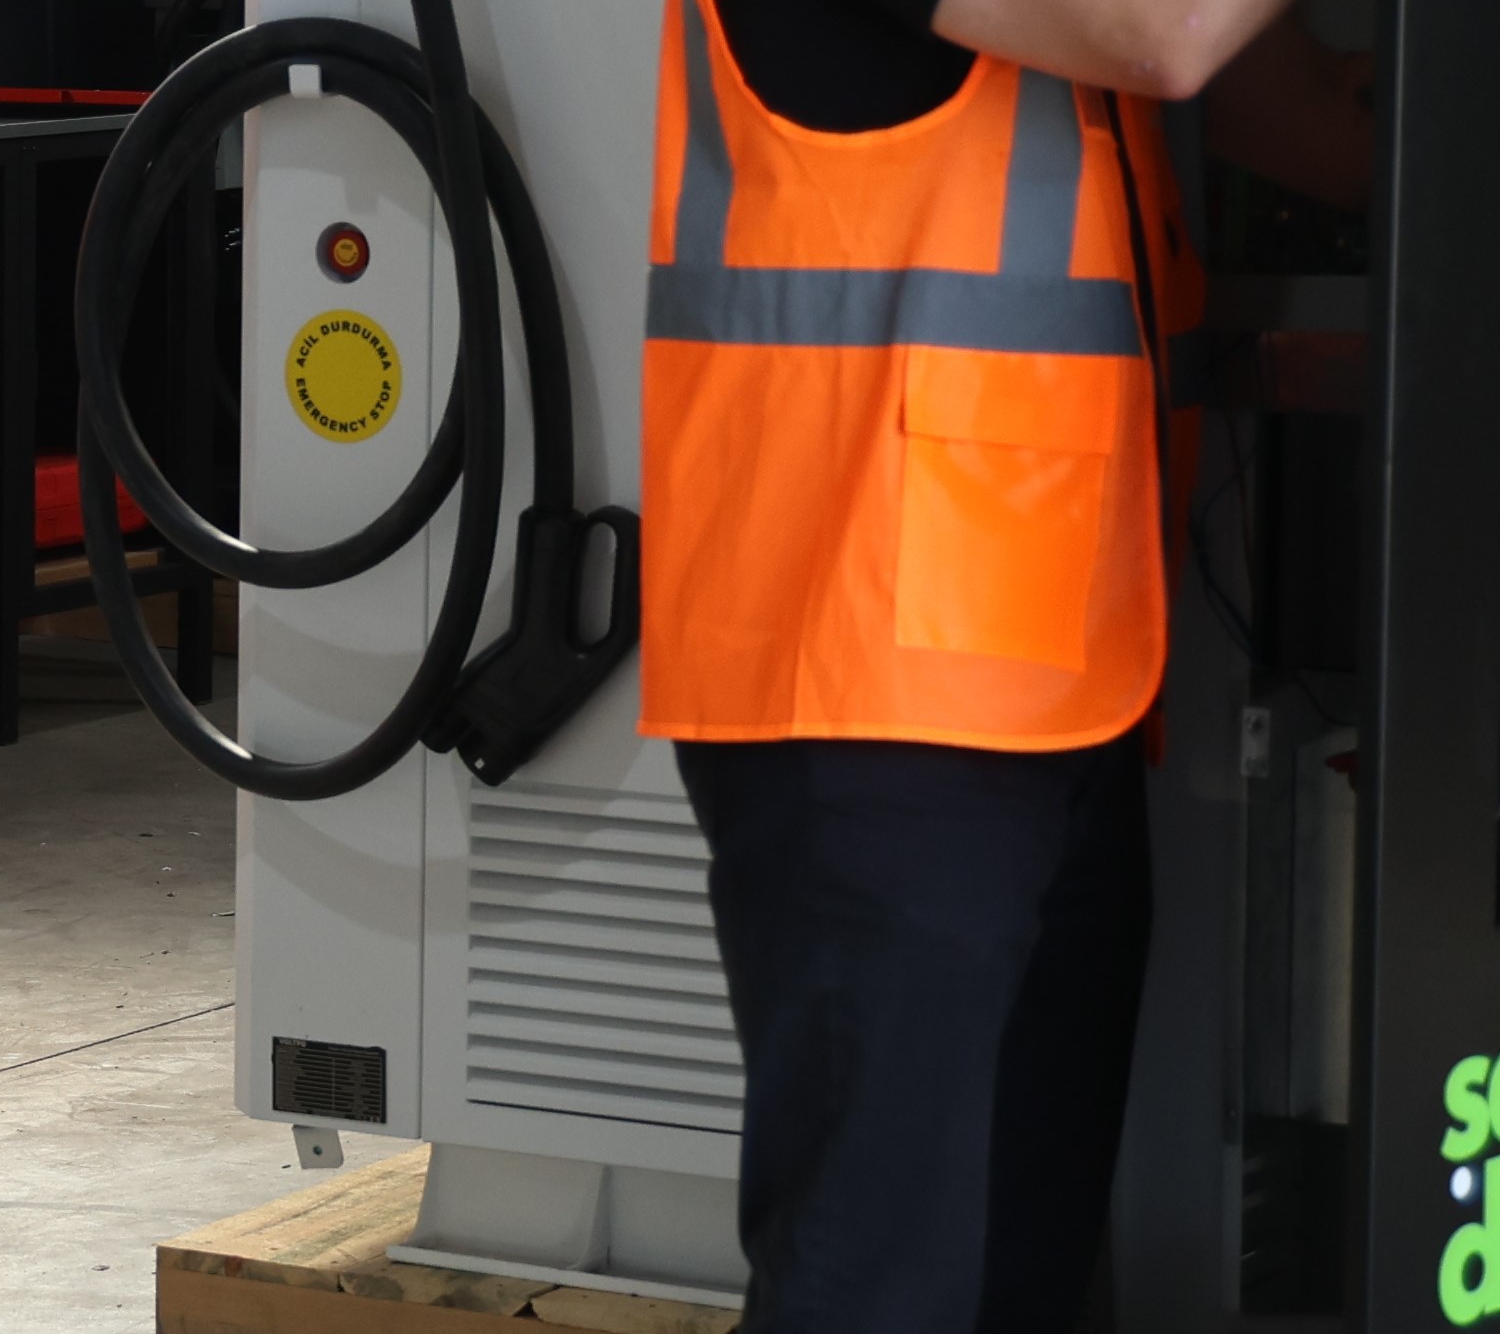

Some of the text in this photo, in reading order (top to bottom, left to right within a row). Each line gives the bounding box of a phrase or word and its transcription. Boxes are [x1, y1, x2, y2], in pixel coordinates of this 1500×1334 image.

[320, 320, 392, 371] DURDURMA
[296, 377, 392, 433] EMERGENCY STOP
